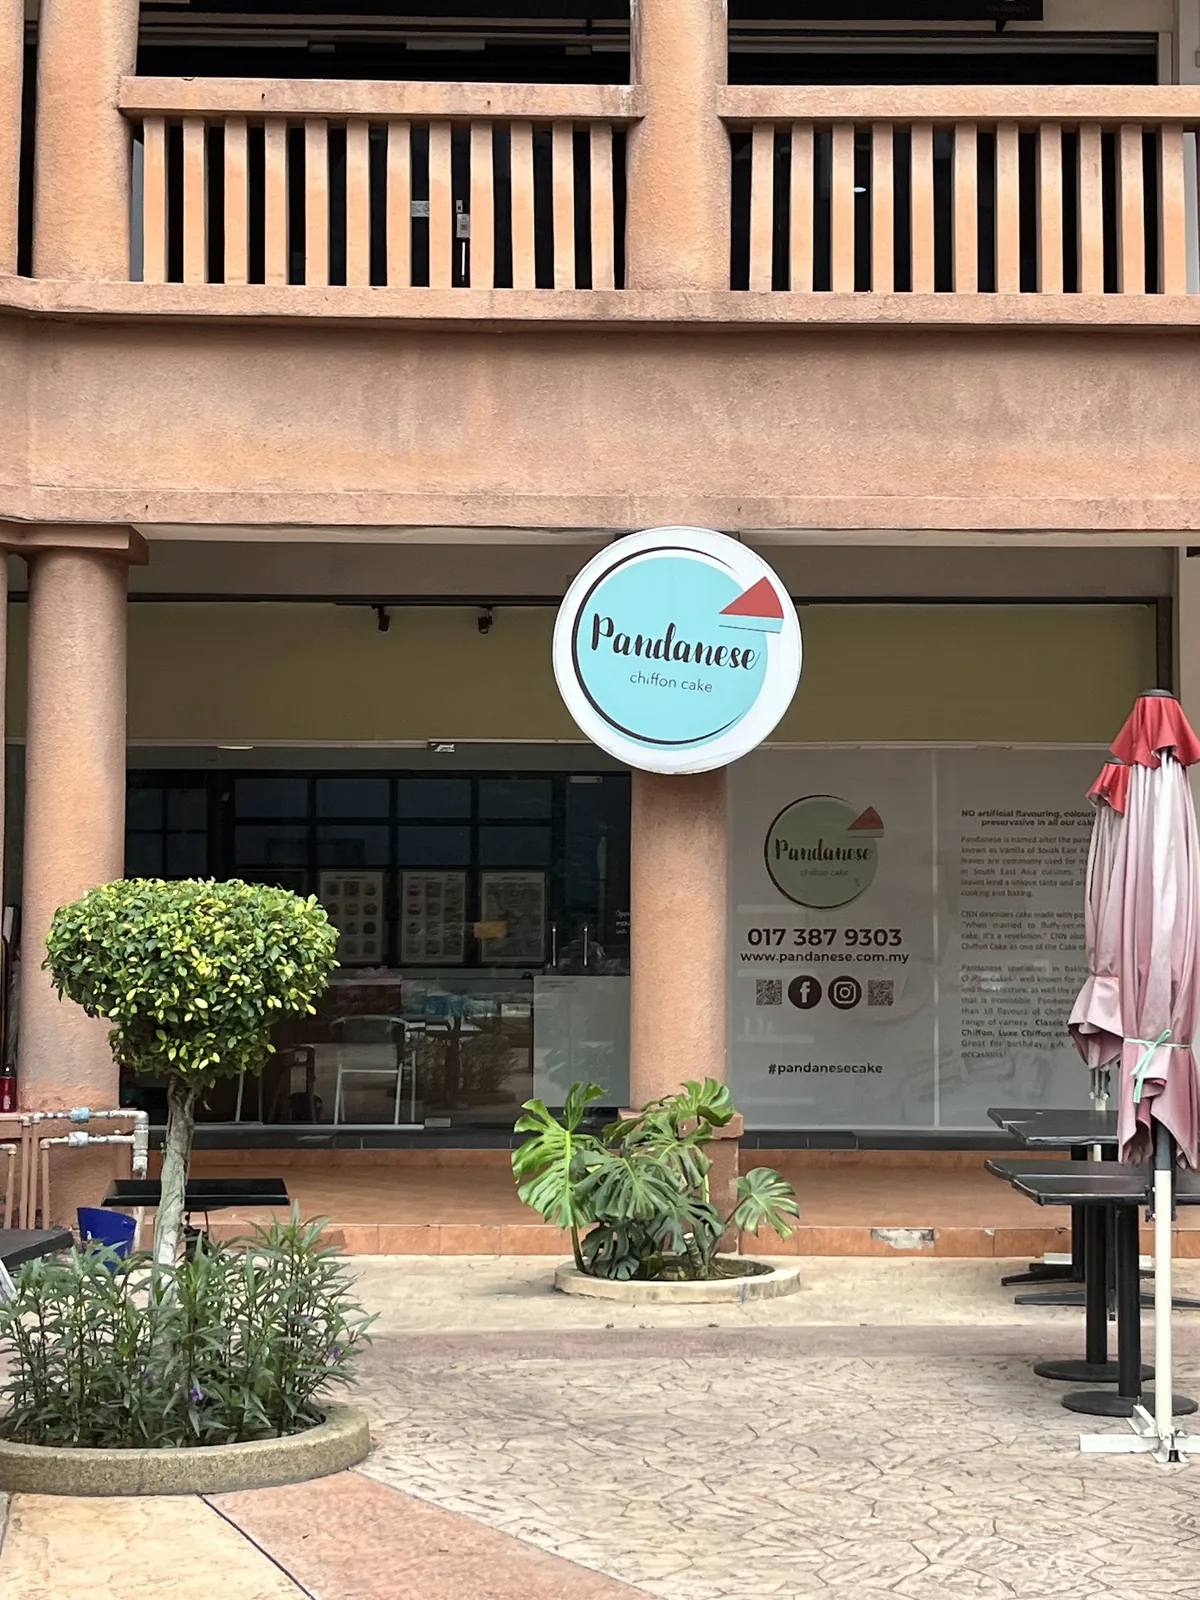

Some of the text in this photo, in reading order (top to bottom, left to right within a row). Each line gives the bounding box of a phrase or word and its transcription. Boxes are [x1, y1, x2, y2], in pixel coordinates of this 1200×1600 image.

[590, 612, 762, 671] Pandanese
[629, 670, 713, 693] chiffon cake
[775, 838, 873, 862] Pandanese
[830, 868, 849, 877] cake
[747, 928, 903, 947] 017 387 9303
[740, 950, 909, 964] www.pandanese.com.my
[768, 1062, 883, 1075] #pandanesecake
